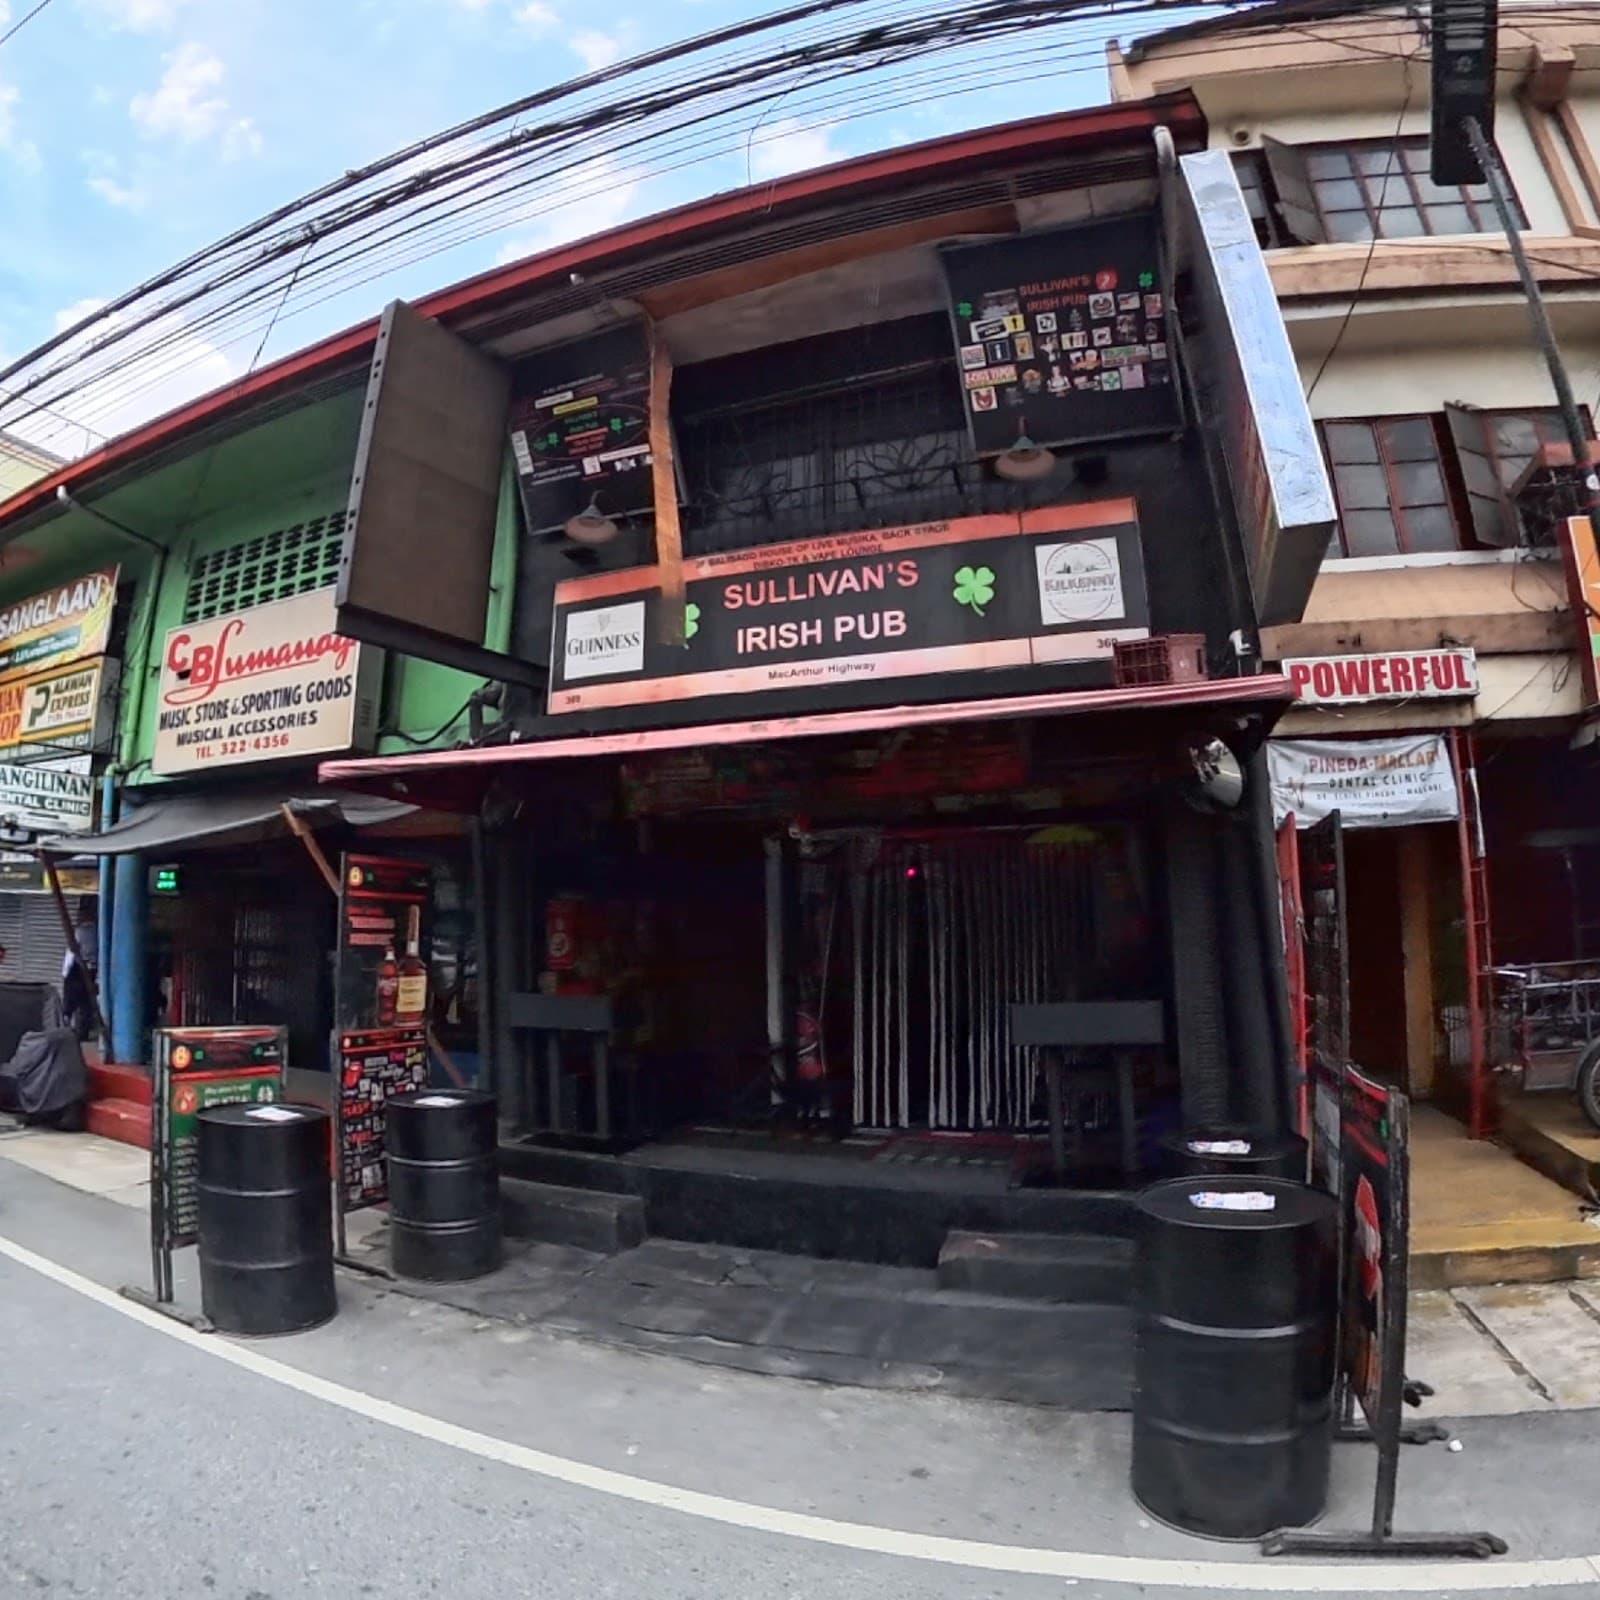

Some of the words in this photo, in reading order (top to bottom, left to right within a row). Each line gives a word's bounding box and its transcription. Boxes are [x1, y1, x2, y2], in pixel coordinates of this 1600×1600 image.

[723, 560, 919, 610] SULLIVAN'S
[567, 632, 641, 657] GUINNESS
[736, 619, 823, 655] IRISH
[834, 610, 907, 642] PUB
[768, 665, 824, 680] MacArthur
[828, 660, 877, 675] Highway
[1289, 654, 1472, 699] POWERFUL
[50, 691, 90, 713] EXPRESS
[159, 707, 191, 731] MUSIC
[195, 699, 229, 724] STORE
[241, 684, 301, 716] SPORTING
[306, 675, 352, 704] GOODS
[177, 727, 223, 747] MUSICAL
[228, 710, 317, 738] ACCESSORIES
[1329, 775, 1376, 789] DENTAL
[1383, 771, 1428, 786] CLINIC
[44, 797, 90, 815] CLINIC
